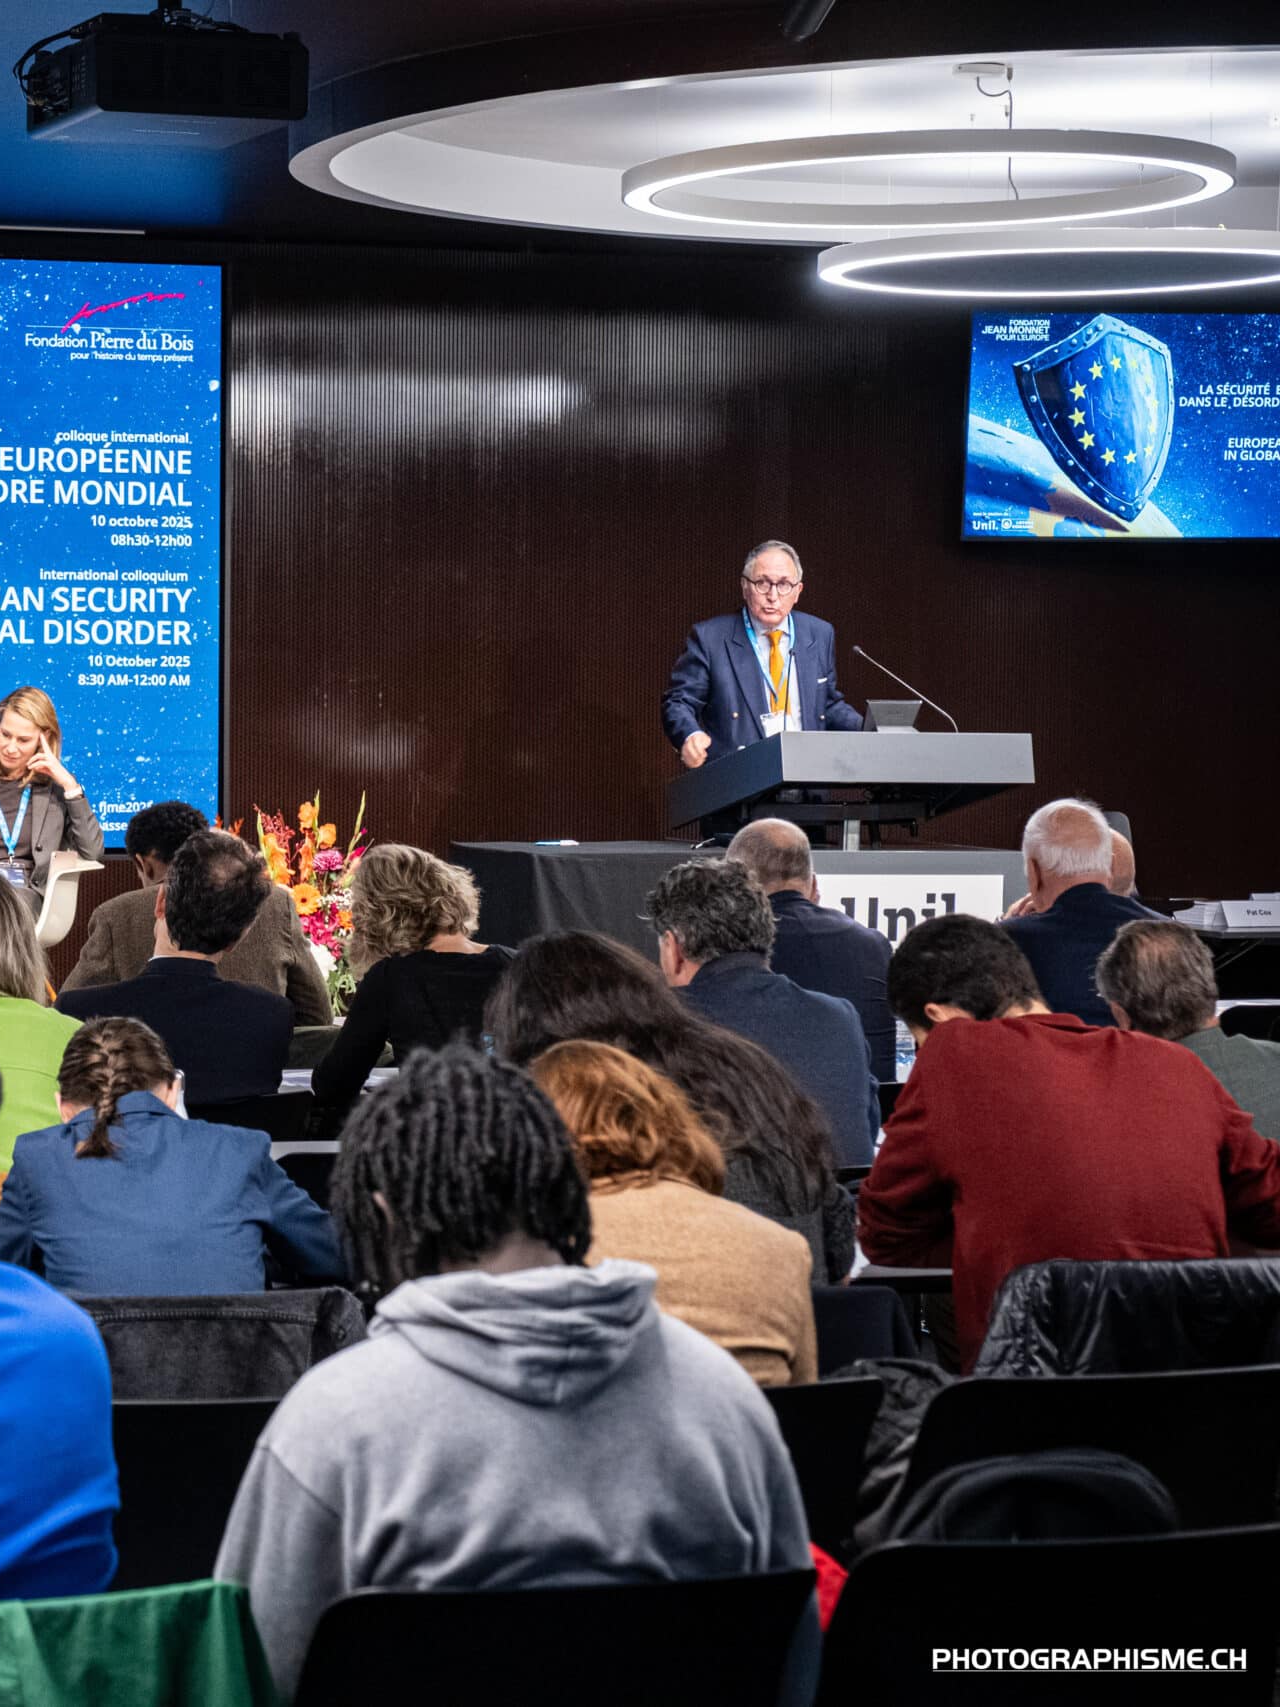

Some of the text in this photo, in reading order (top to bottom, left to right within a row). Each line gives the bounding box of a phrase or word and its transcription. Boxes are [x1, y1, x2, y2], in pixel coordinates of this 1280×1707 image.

[982, 325, 1050, 334] JEAN MONNET
[25, 330, 194, 351] Fondation Pierre du Bois
[70, 351, 89, 360] pour
[124, 351, 136, 361] du
[137, 352, 162, 363] temps
[1200, 385, 1214, 395] LA
[1216, 382, 1271, 395] SÉCURITÉ
[1179, 397, 1211, 407] DANS
[1214, 397, 1227, 407] LE
[57, 430, 189, 444] colloque international
[0, 442, 192, 475] EUROPÉENNE
[1224, 449, 1237, 461] IN
[54, 480, 192, 506] MONDIAL
[90, 515, 192, 528] 10 octobre 2025
[110, 534, 193, 547] 08h30-12h00
[39, 568, 188, 584] international colloquium
[52, 587, 192, 613] SECURITY
[44, 620, 192, 645] DISORDER
[87, 655, 191, 667] 10 October 2025
[78, 674, 191, 686] 8:30 AM-12:00 AM
